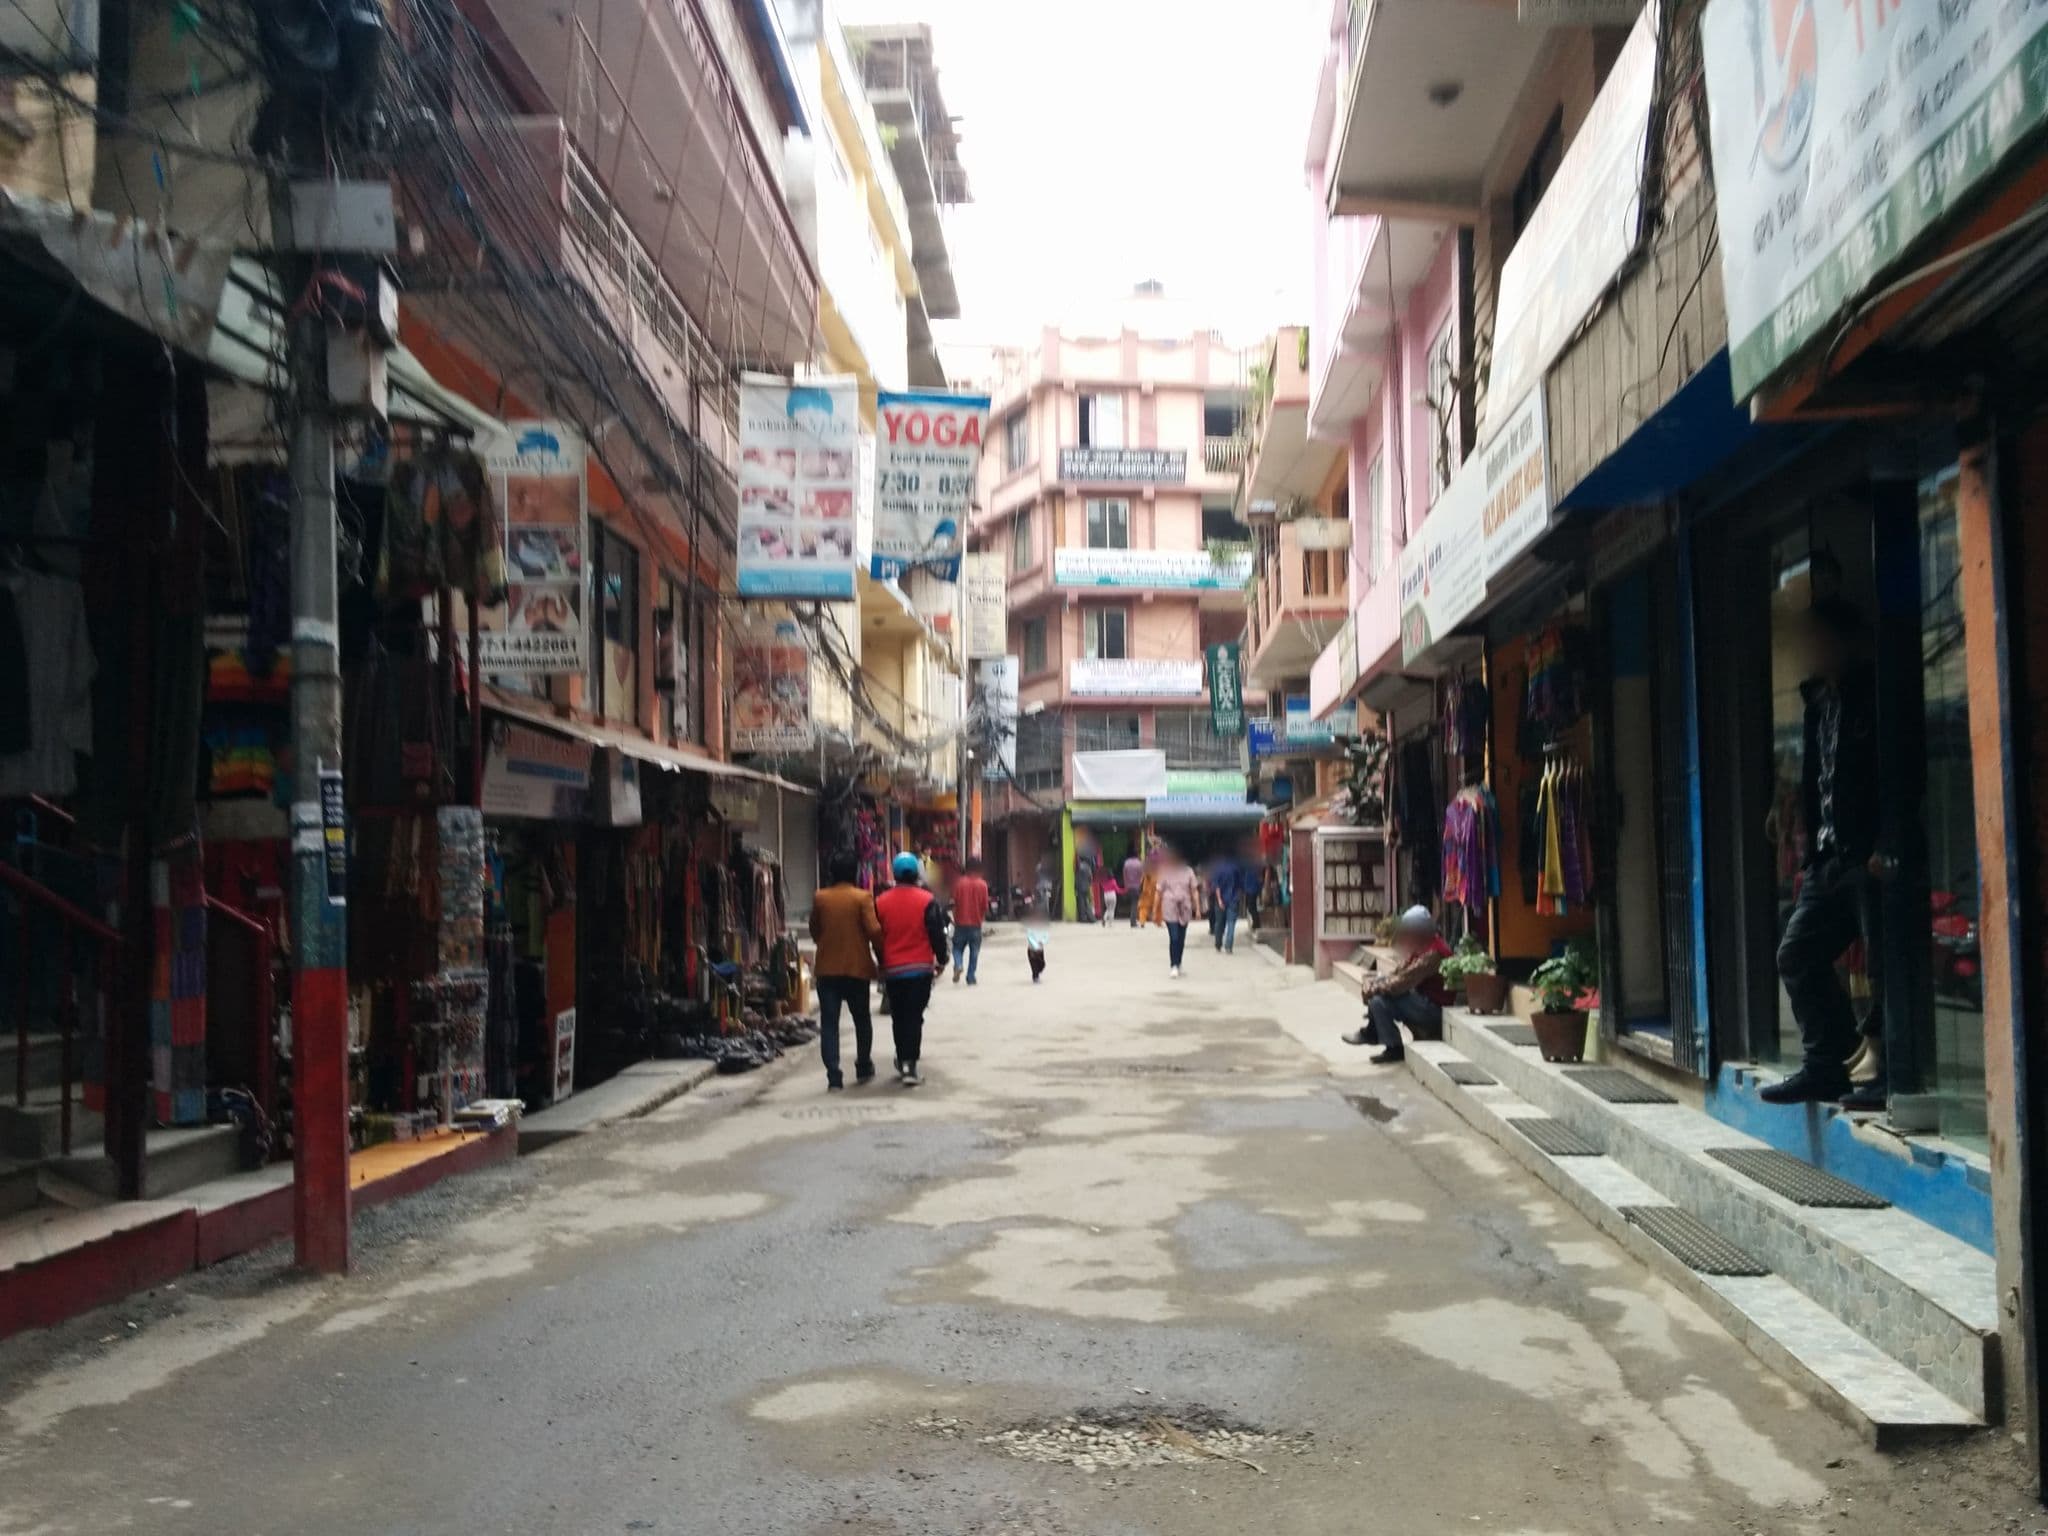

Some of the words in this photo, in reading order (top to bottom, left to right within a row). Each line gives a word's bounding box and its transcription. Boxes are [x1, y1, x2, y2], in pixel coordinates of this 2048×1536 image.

[1773, 278, 1821, 350] NEPAL
[1838, 195, 1890, 283] TIBET
[1917, 64, 2025, 209] BHUTAN
[883, 409, 981, 447] YOGA
[890, 454, 922, 466] Every
[879, 470, 920, 494] 7:30
